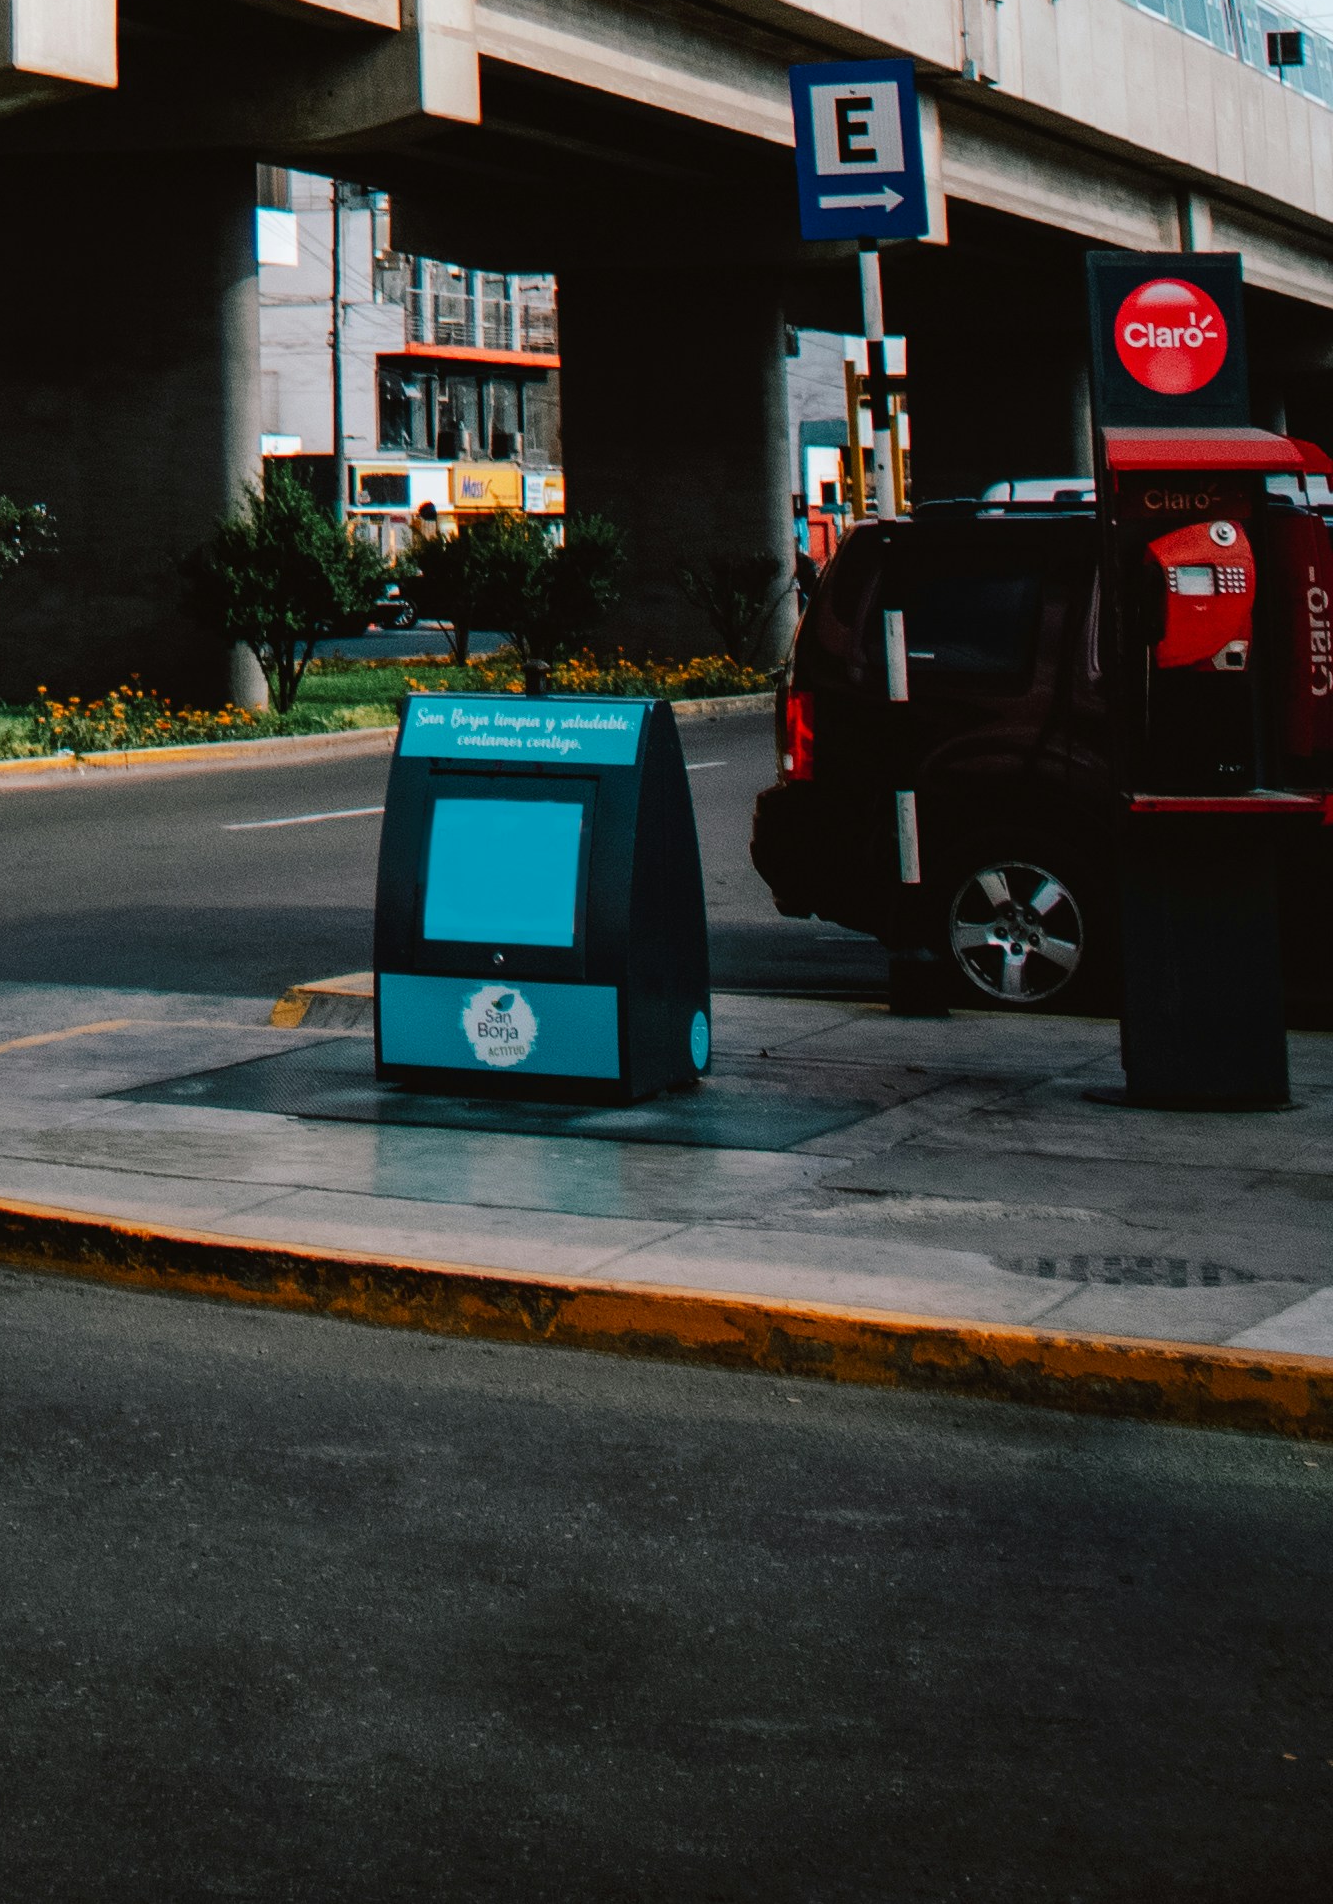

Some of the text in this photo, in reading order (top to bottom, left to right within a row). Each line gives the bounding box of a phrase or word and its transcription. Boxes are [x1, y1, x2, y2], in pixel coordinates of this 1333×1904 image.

[835, 96, 878, 163] E
[1123, 319, 1206, 348] Claro
[1143, 489, 1210, 510] Claro
[1307, 586, 1333, 696] Claro
[415, 707, 445, 727] San
[450, 707, 489, 732] Borja
[494, 711, 541, 732] limpia
[545, 717, 556, 733] y
[457, 733, 522, 749] contamos
[485, 1009, 512, 1026] San
[477, 1022, 519, 1043] Borja
[488, 1045, 526, 1057] ACTITUD
